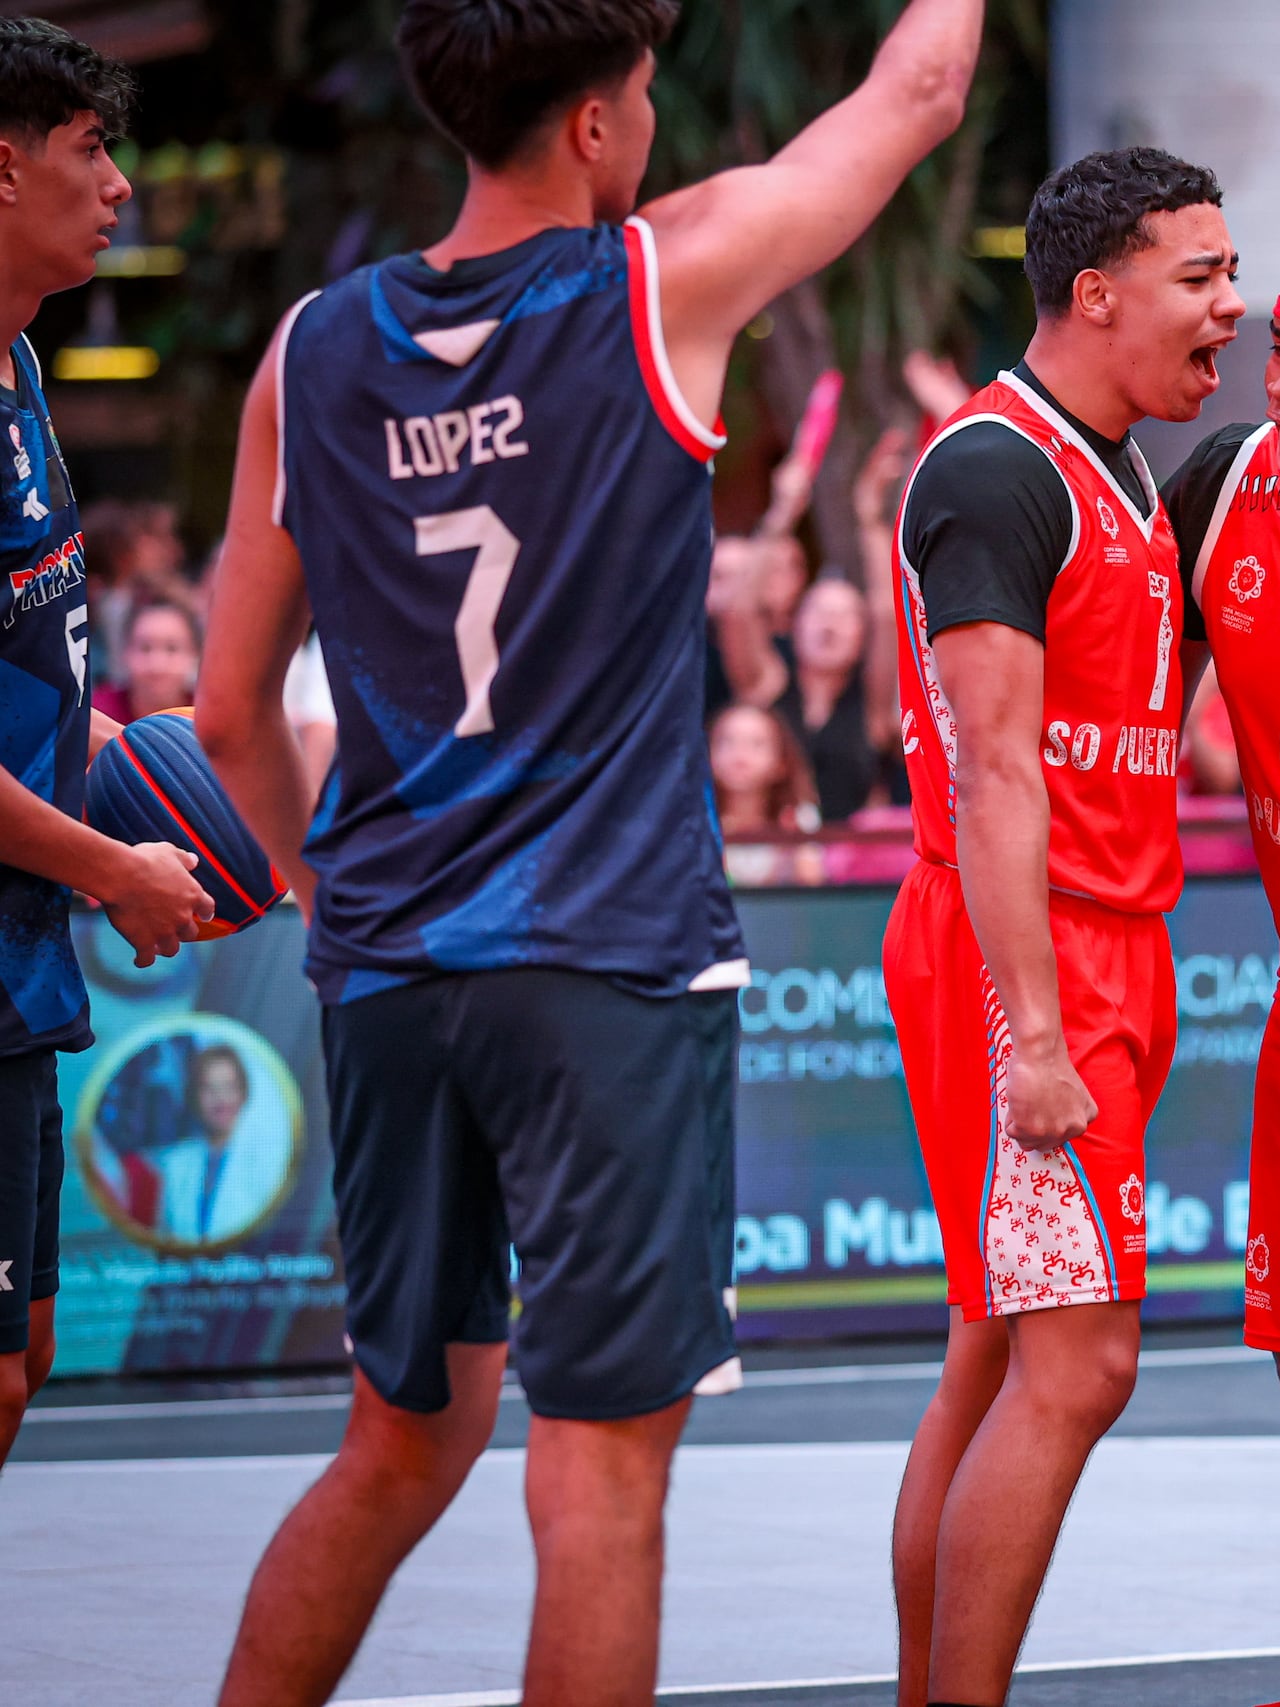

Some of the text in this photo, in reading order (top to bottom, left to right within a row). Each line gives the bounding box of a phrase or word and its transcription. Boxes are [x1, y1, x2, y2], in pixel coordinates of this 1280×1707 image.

[384, 395, 529, 480] LOPEZ
[414, 504, 520, 738] 7
[788, 1039, 901, 1081] FOND
[732, 1213, 809, 1285] pa
